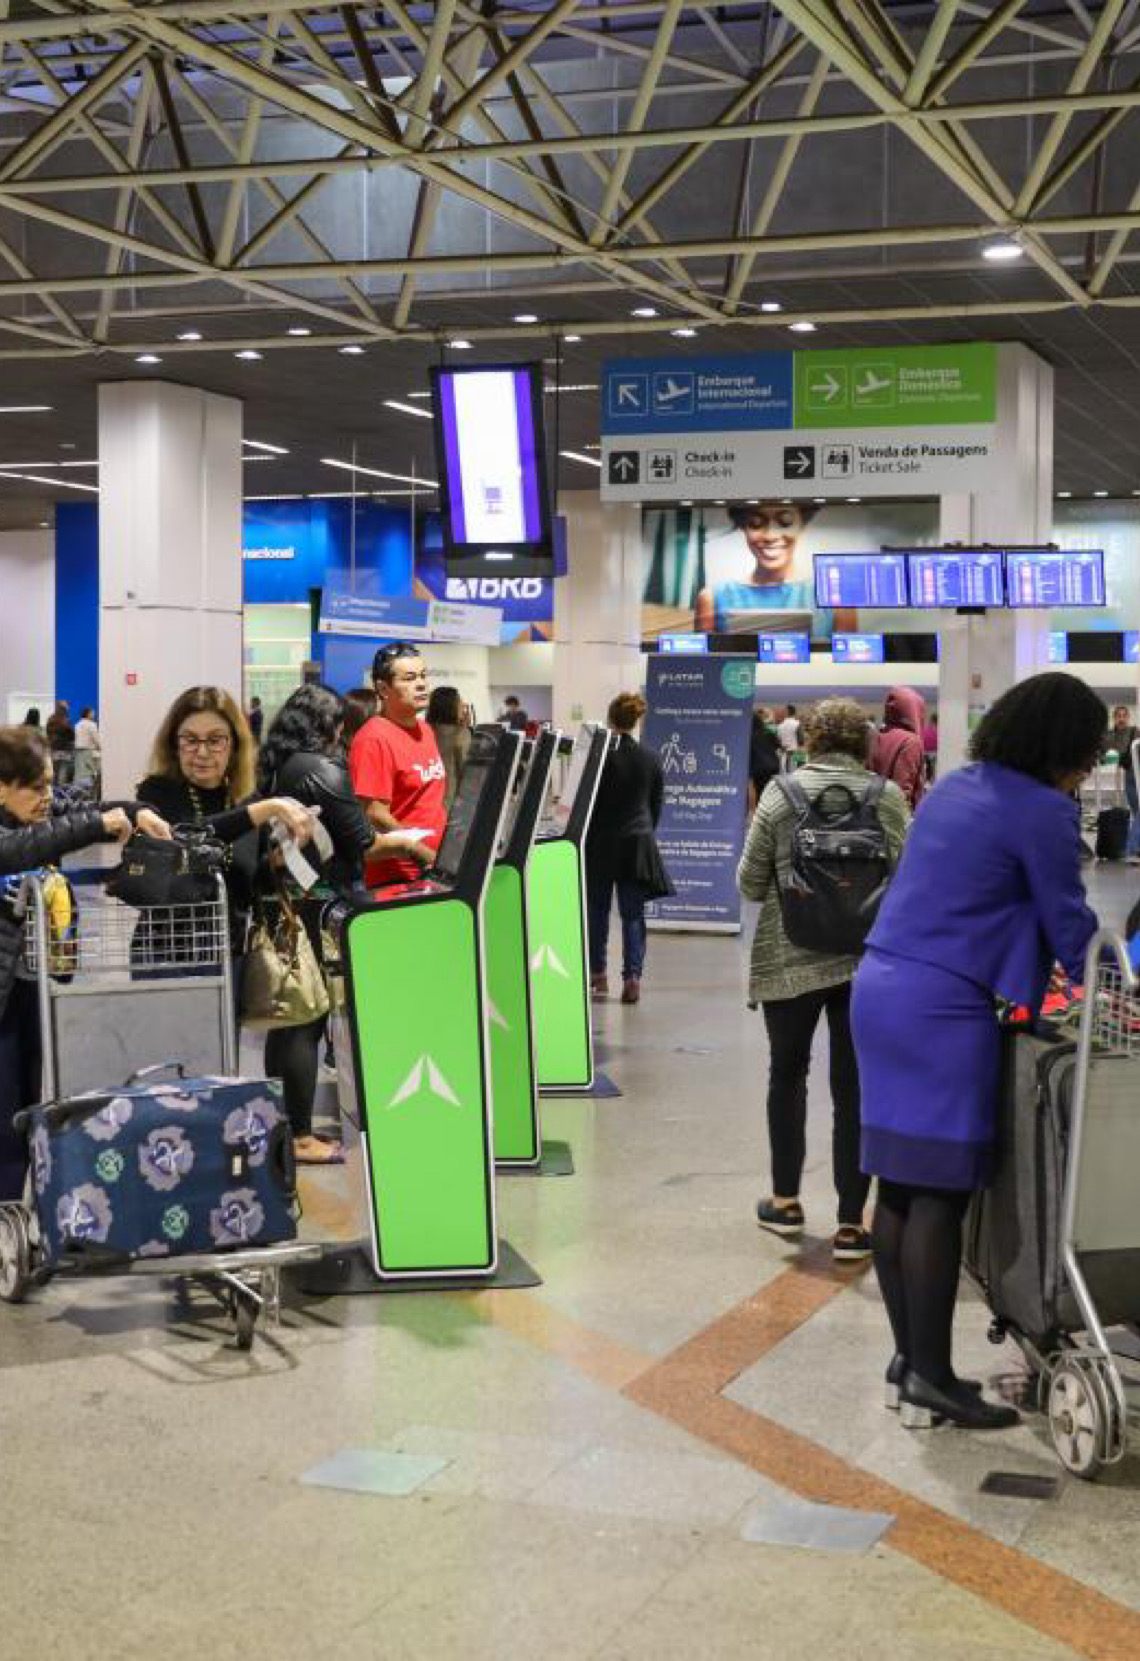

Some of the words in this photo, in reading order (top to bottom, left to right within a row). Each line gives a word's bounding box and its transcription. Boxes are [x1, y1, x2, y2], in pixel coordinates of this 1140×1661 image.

[685, 450, 735, 463] Check-in
[858, 445, 899, 458] Venda
[901, 444, 919, 456] de
[921, 443, 988, 458] Passagens
[859, 461, 895, 474] Ticket
[897, 460, 922, 474] Sale
